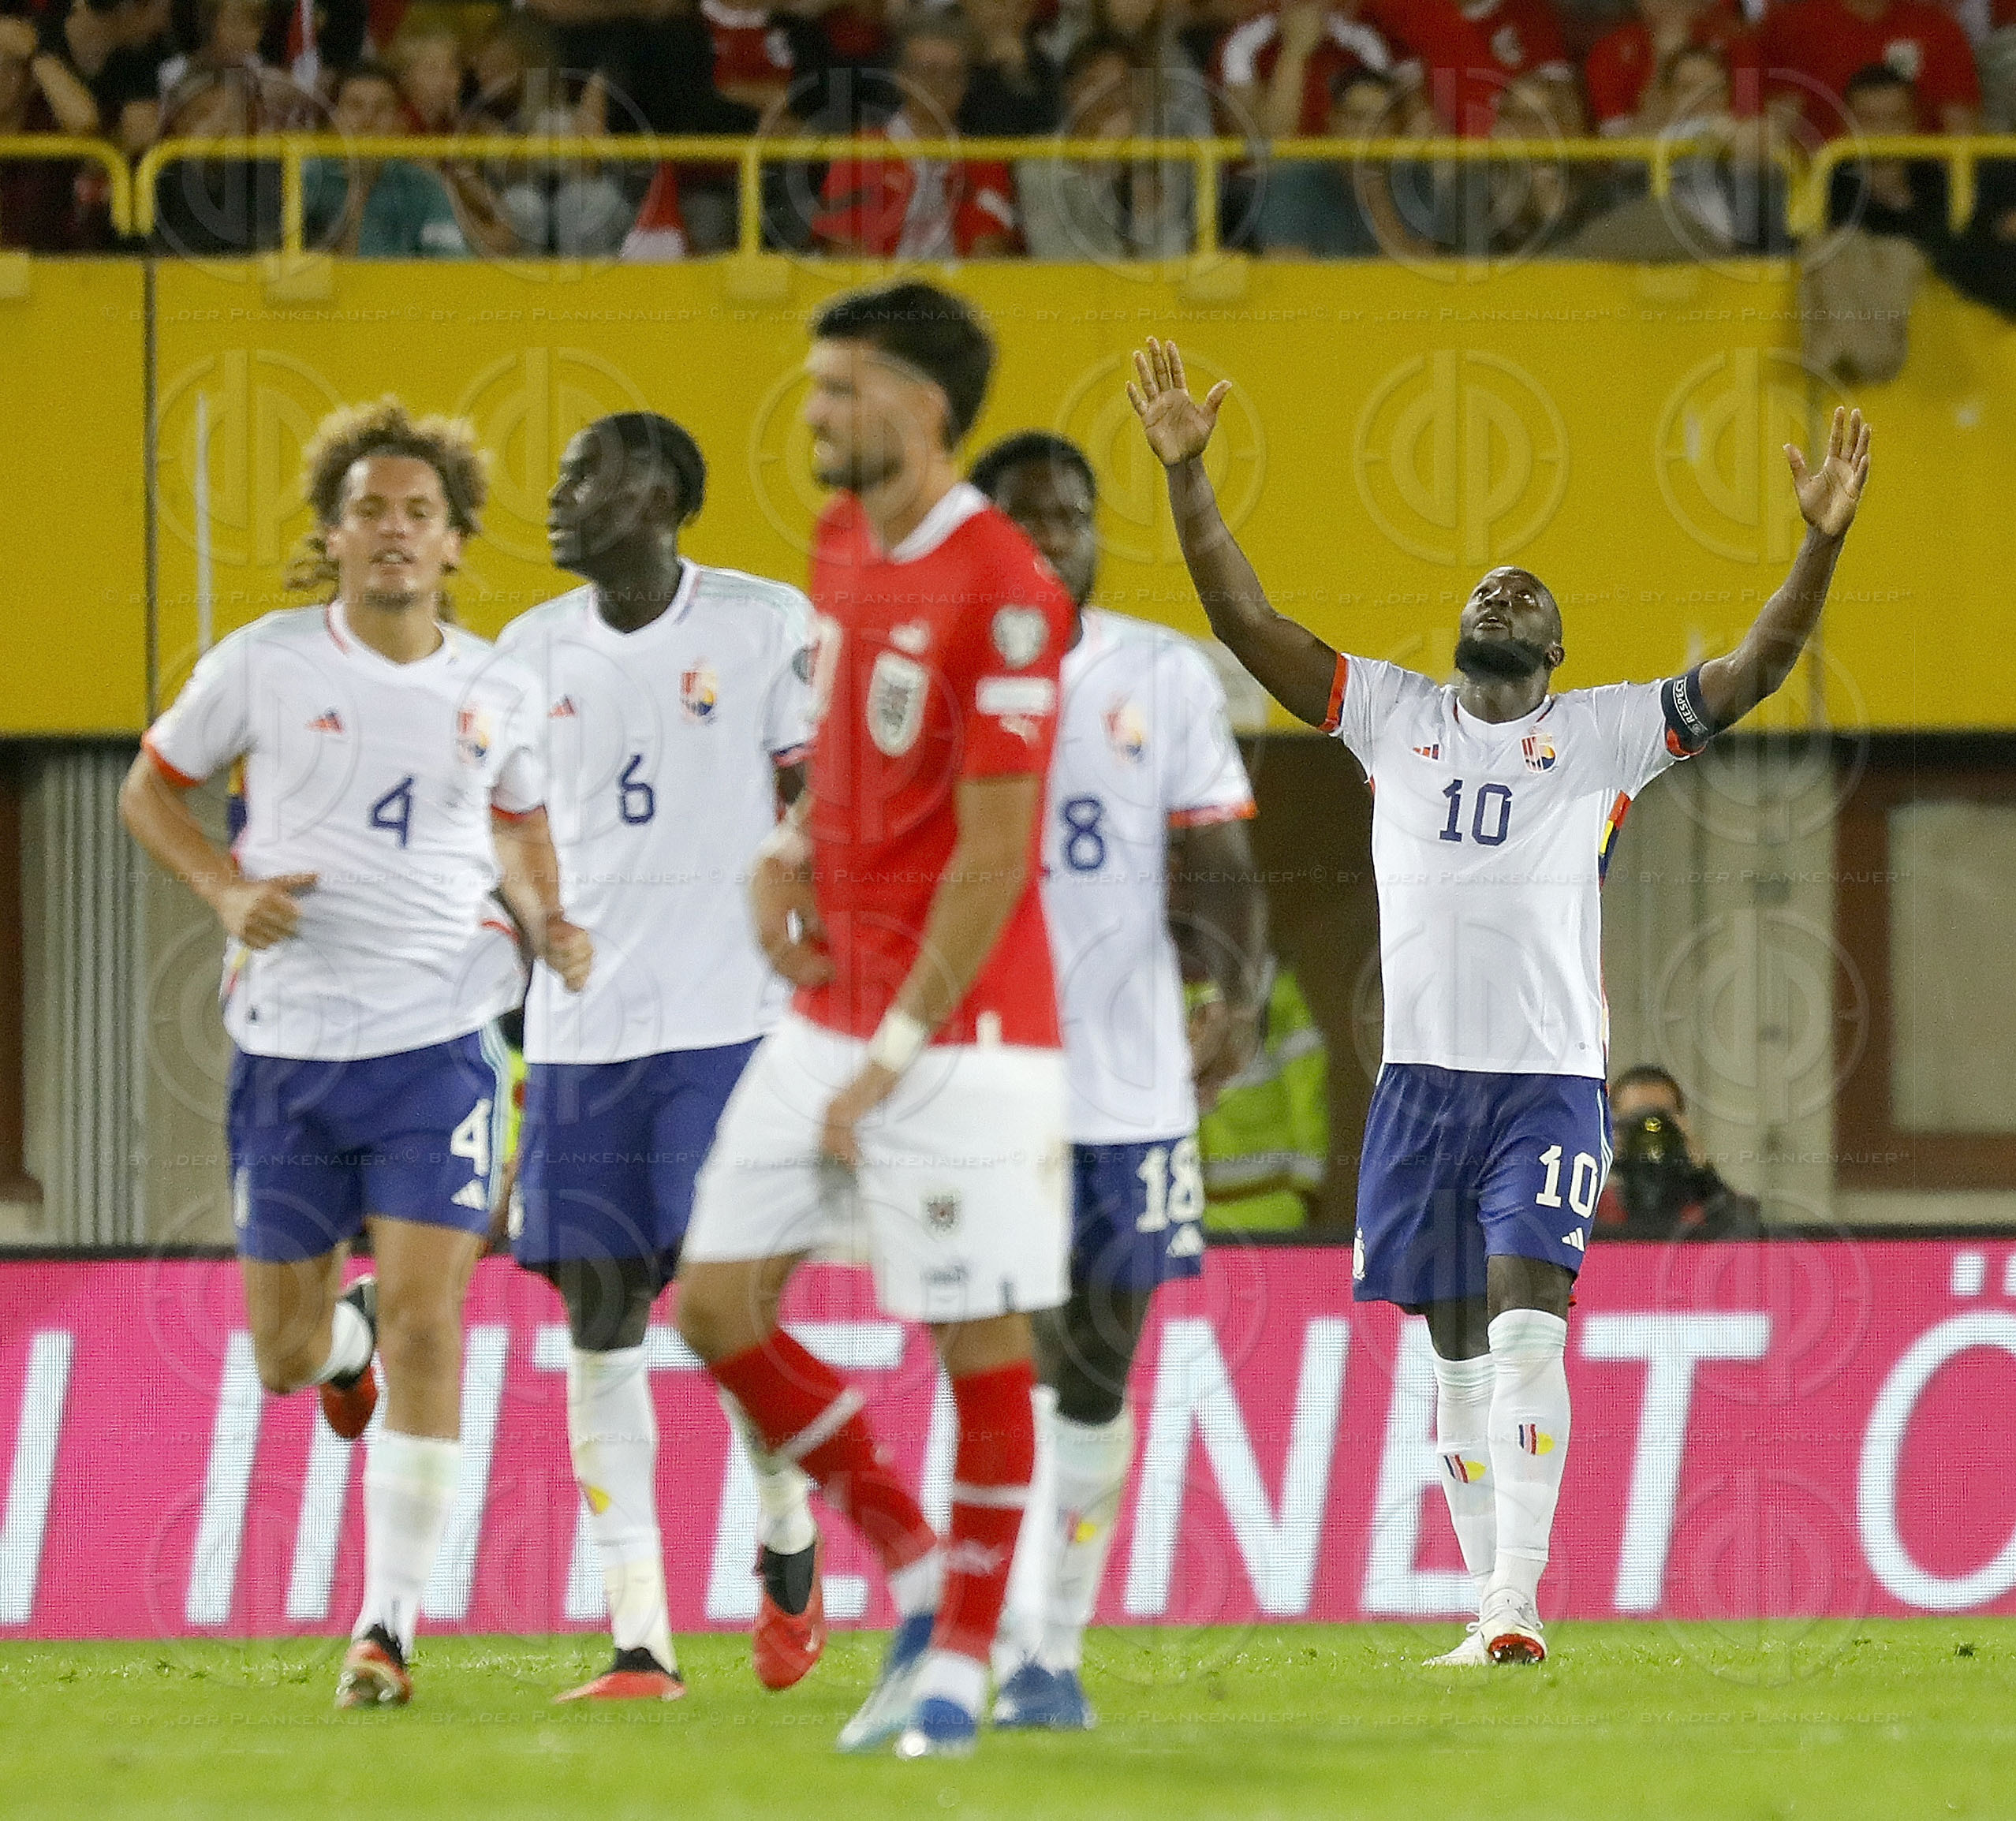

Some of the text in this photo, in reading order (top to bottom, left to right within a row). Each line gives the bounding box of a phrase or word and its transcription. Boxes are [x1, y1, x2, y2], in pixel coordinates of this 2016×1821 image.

[1675, 679, 1696, 723] RESPECT
[369, 774, 416, 849] 4
[618, 752, 655, 826] 6
[1439, 778, 1513, 846] 10
[1043, 794, 1106, 872] 8
[449, 1097, 494, 1177] 4
[1135, 1138, 1205, 1233] 18
[1535, 1144, 1599, 1219] 10
